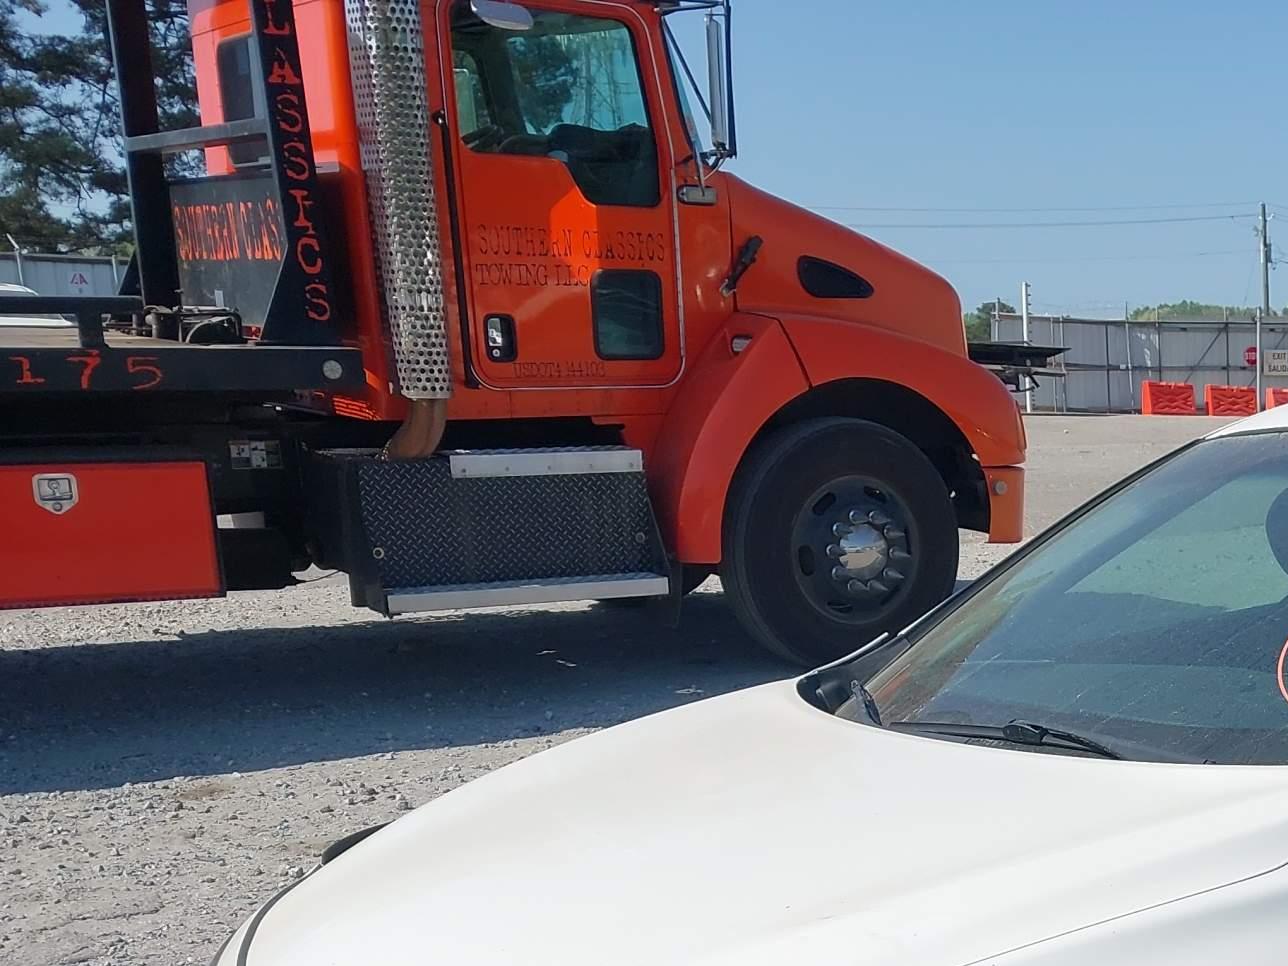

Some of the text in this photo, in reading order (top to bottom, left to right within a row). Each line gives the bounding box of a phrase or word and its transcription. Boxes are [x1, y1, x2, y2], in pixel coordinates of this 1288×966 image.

[478, 224, 666, 261] SOUTHERN CLASSICS
[476, 263, 590, 287] TOWING LLC
[1272, 352, 1287, 360] EXIT
